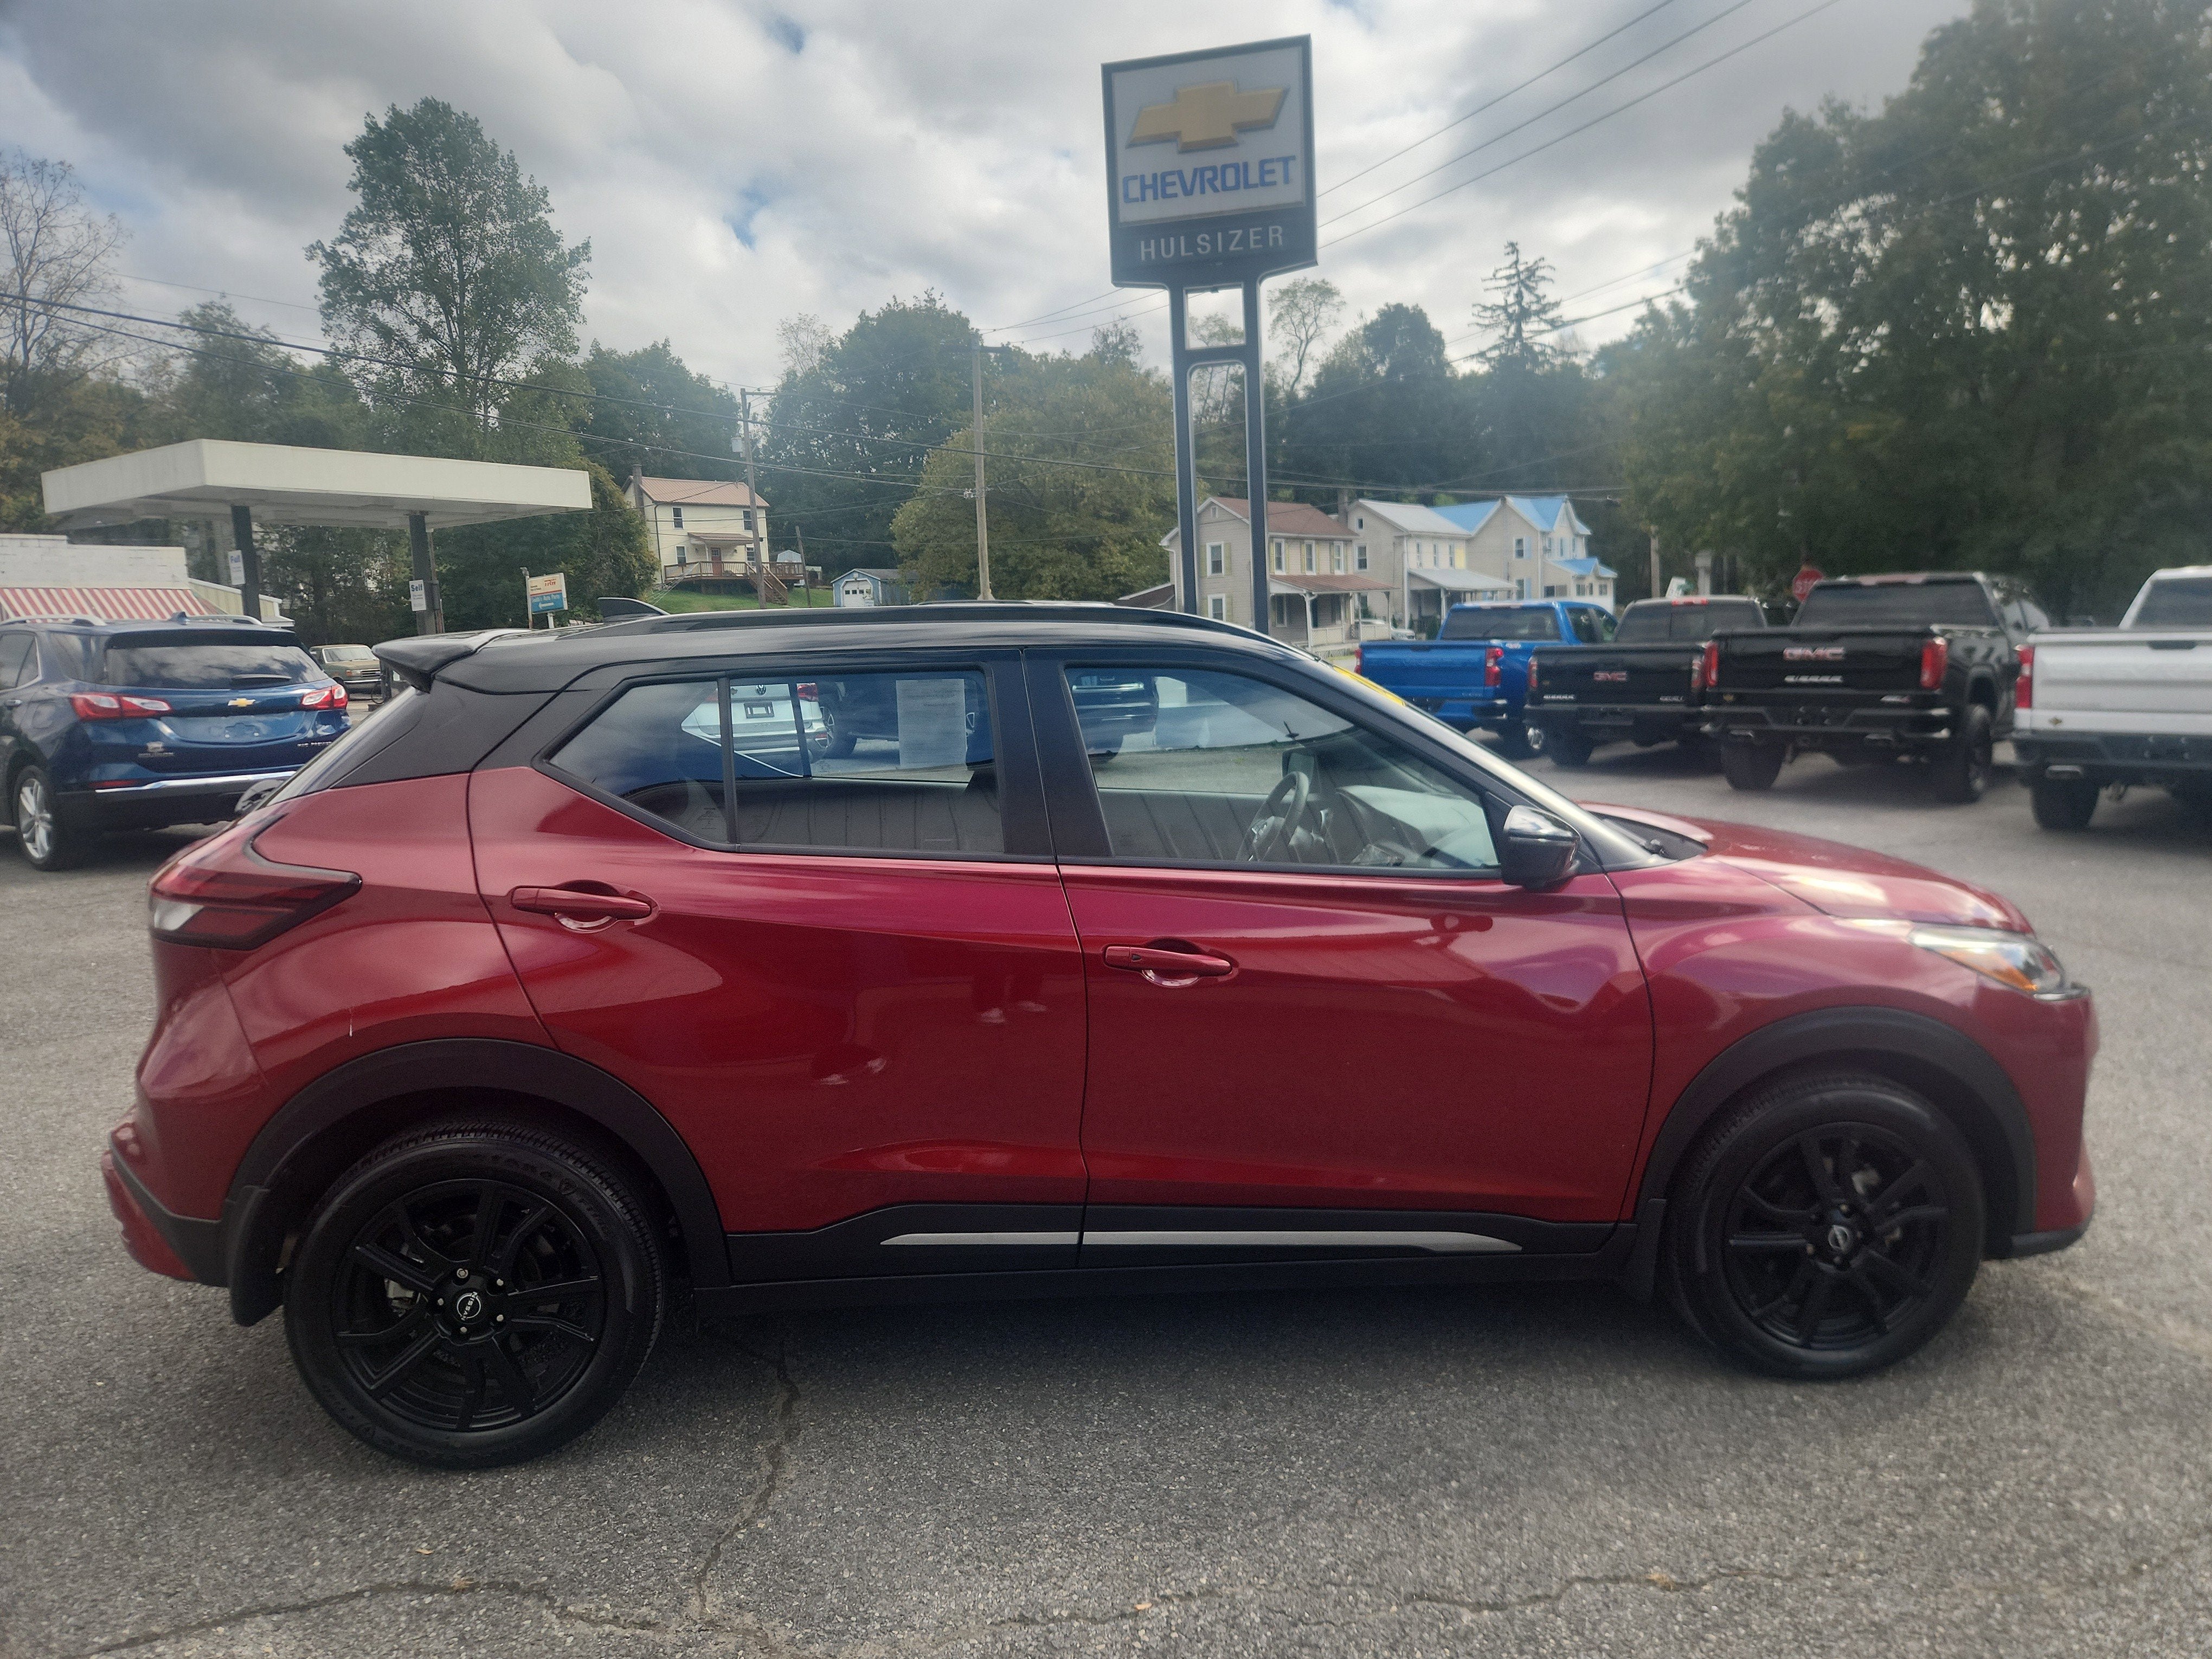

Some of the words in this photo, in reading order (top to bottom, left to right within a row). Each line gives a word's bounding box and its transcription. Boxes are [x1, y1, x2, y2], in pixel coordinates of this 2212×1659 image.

[1122, 155, 1296, 203] CHEVROLET
[1140, 226, 1283, 261] HULSIZER
[411, 583, 423, 591] Self
[1783, 647, 1843, 660] GMC
[1594, 671, 1626, 681] GMC
[461, 1291, 478, 1321] NISSAN
